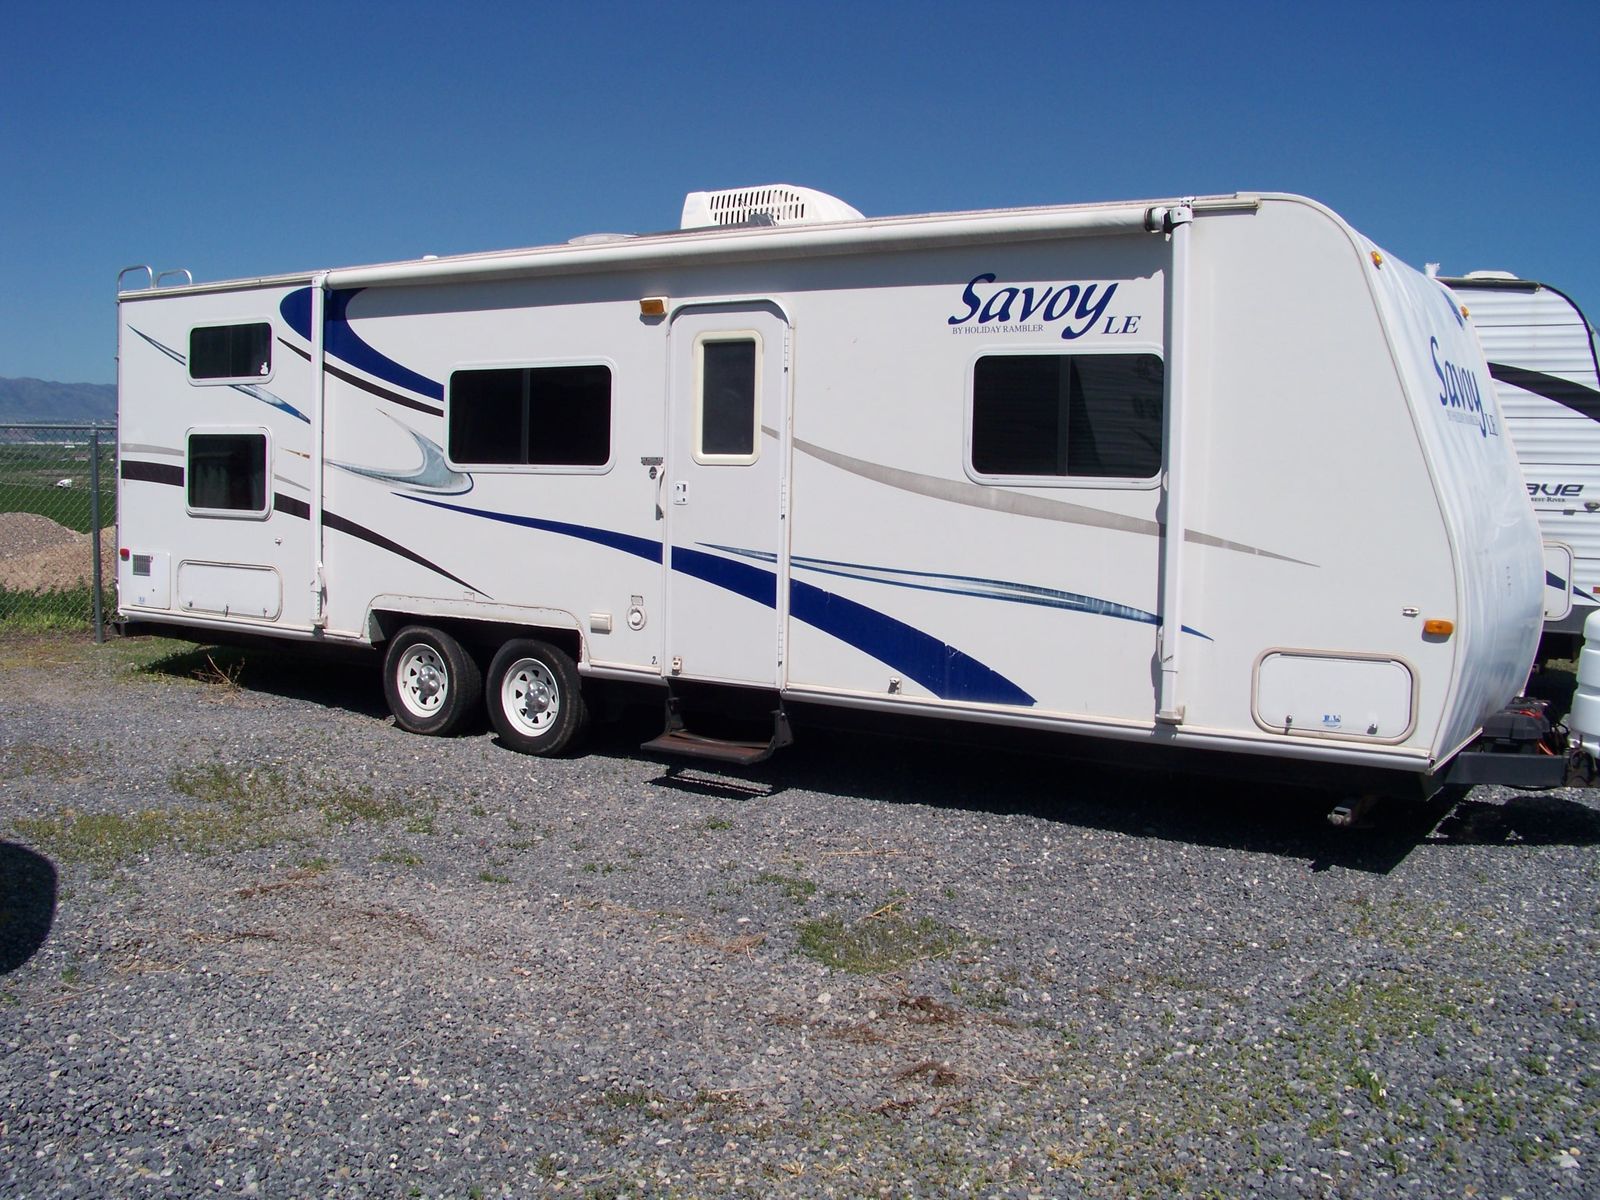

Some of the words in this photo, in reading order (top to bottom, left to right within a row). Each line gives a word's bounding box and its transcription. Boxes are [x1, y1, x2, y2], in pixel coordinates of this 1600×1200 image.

[948, 273, 1119, 340] Savoy
[1102, 315, 1142, 334] LE
[952, 327, 963, 335] BY
[964, 325, 1001, 334] HOLIDAY
[1002, 324, 1045, 333] RAMBLER
[1430, 335, 1487, 438] Savoy
